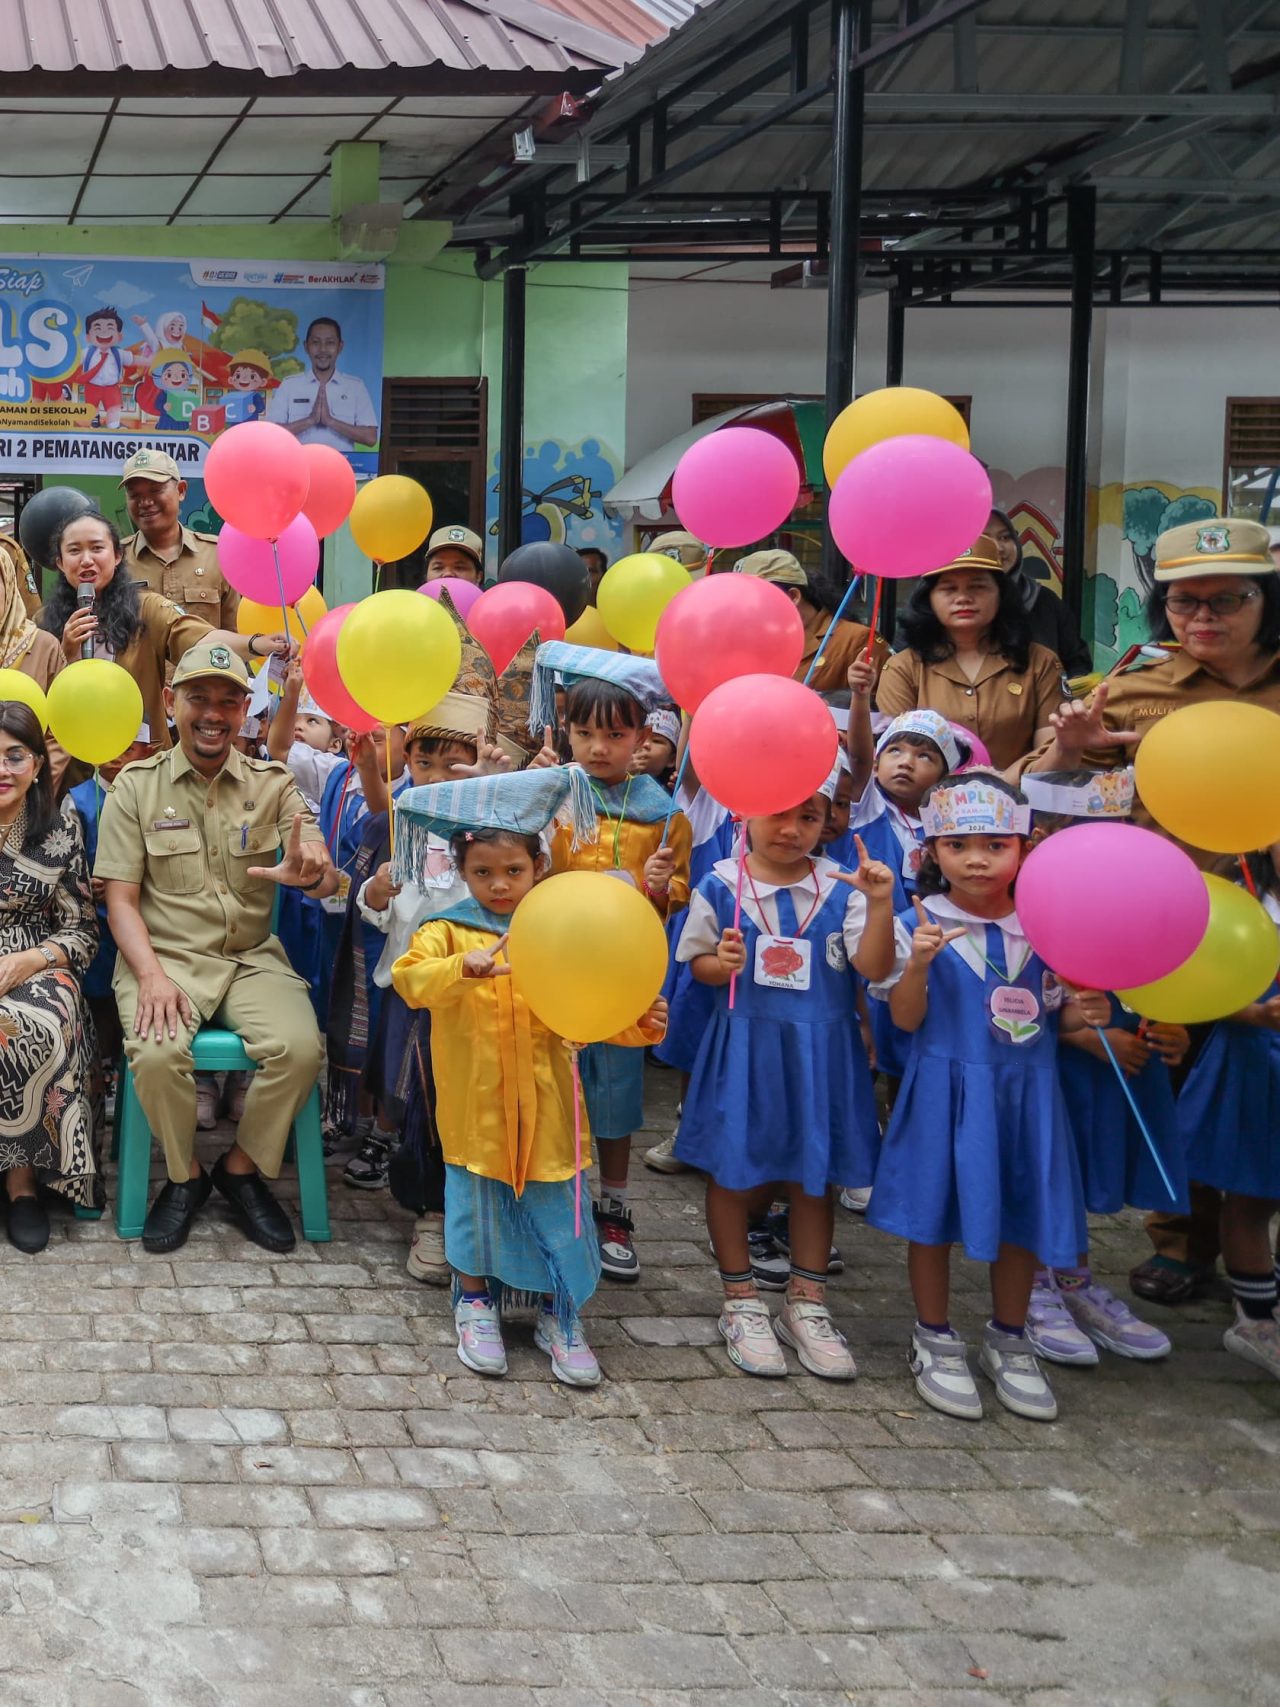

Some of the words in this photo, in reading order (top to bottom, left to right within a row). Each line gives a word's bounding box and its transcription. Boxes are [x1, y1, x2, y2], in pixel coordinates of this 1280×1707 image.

[308, 274, 356, 284] BerAKHLAK
[30, 406, 41, 414] DI
[42, 406, 87, 415] SEKOLAH
[181, 401, 195, 416] D
[225, 403, 237, 418] C
[197, 415, 210, 431] B
[17, 439, 27, 458] 2
[953, 790, 995, 806] MPLS
[768, 980, 794, 989] YOHANA
